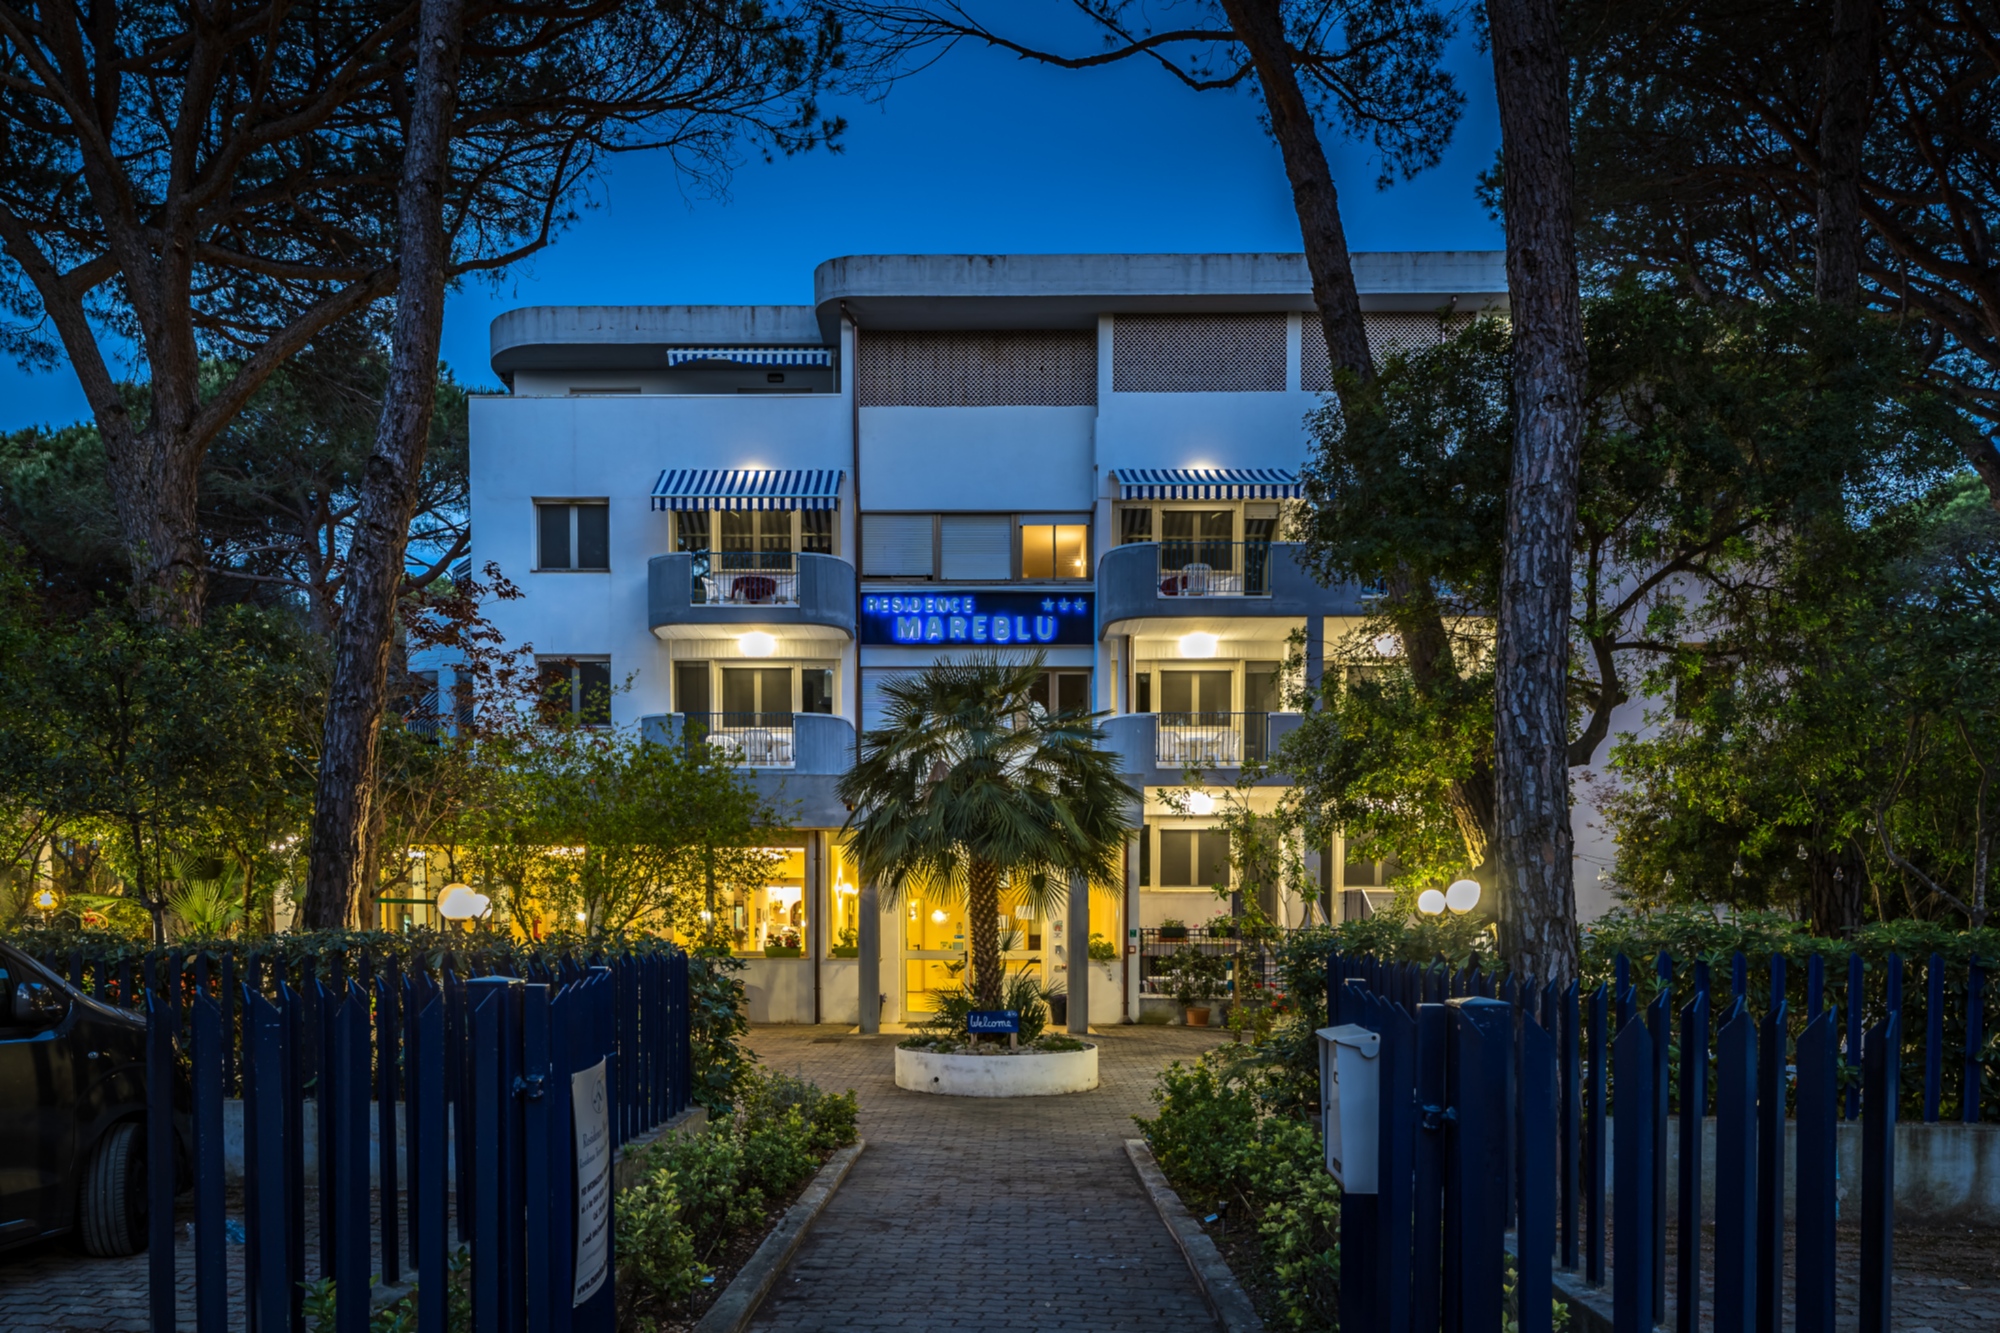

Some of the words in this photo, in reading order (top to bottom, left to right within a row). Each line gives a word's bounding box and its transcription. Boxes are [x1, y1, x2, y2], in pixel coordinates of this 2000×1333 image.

[866, 597, 973, 613] RESIDENCE
[896, 615, 1054, 640] MAREBLU
[970, 1015, 1012, 1027] Welcome
